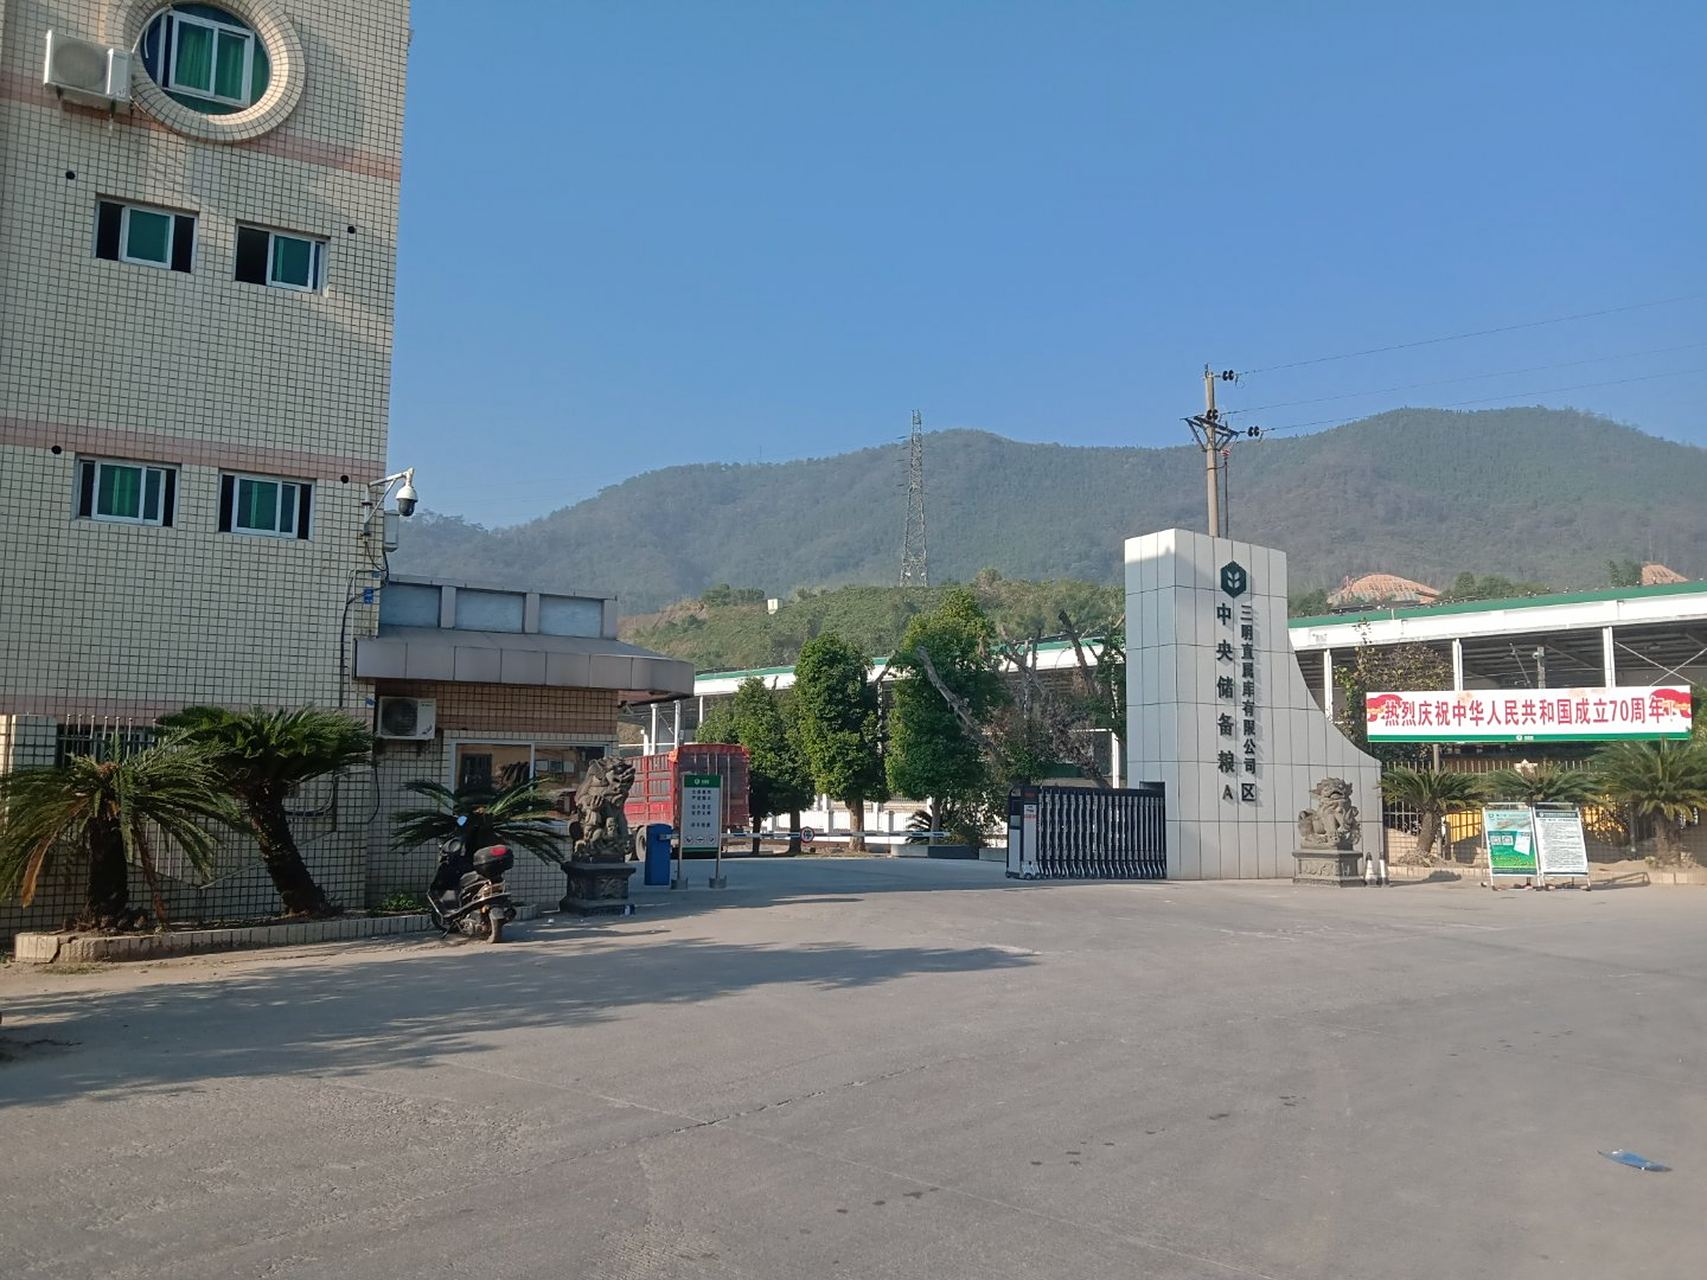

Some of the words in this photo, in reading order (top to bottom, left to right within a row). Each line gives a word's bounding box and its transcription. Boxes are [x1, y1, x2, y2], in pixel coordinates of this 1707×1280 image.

[1216, 602, 1235, 773] 中央储备粮
